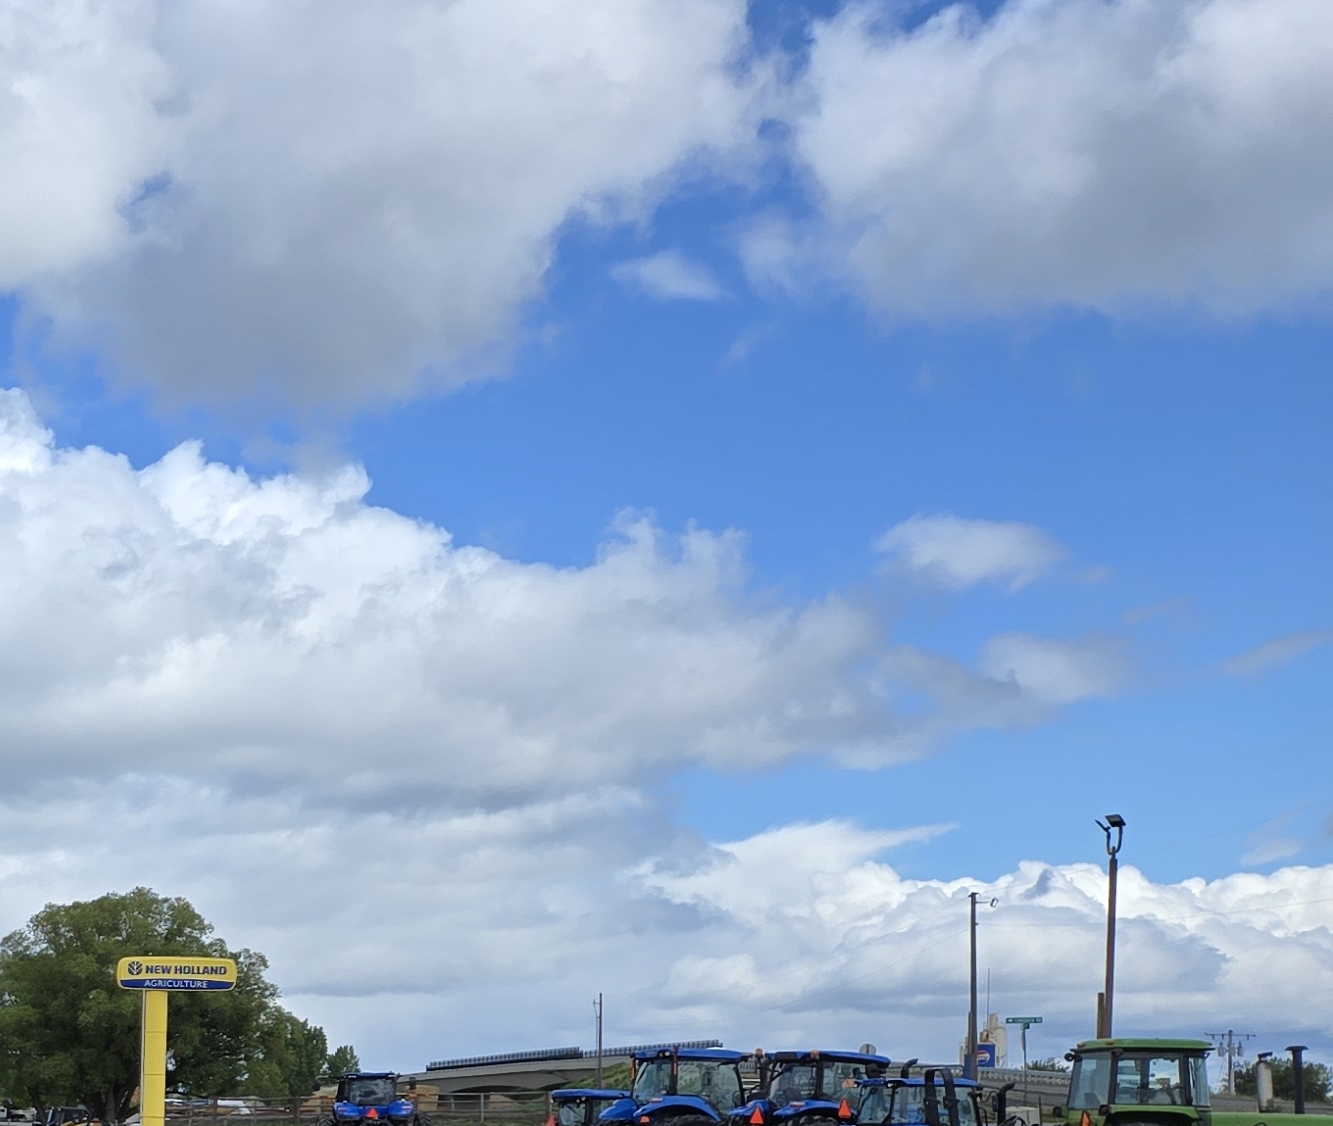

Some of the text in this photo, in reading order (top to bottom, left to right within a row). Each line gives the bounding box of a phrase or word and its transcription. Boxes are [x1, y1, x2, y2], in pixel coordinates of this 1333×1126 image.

[145, 965, 227, 976] NEW HOLLAND
[144, 979, 208, 988] AGRICULTURE
